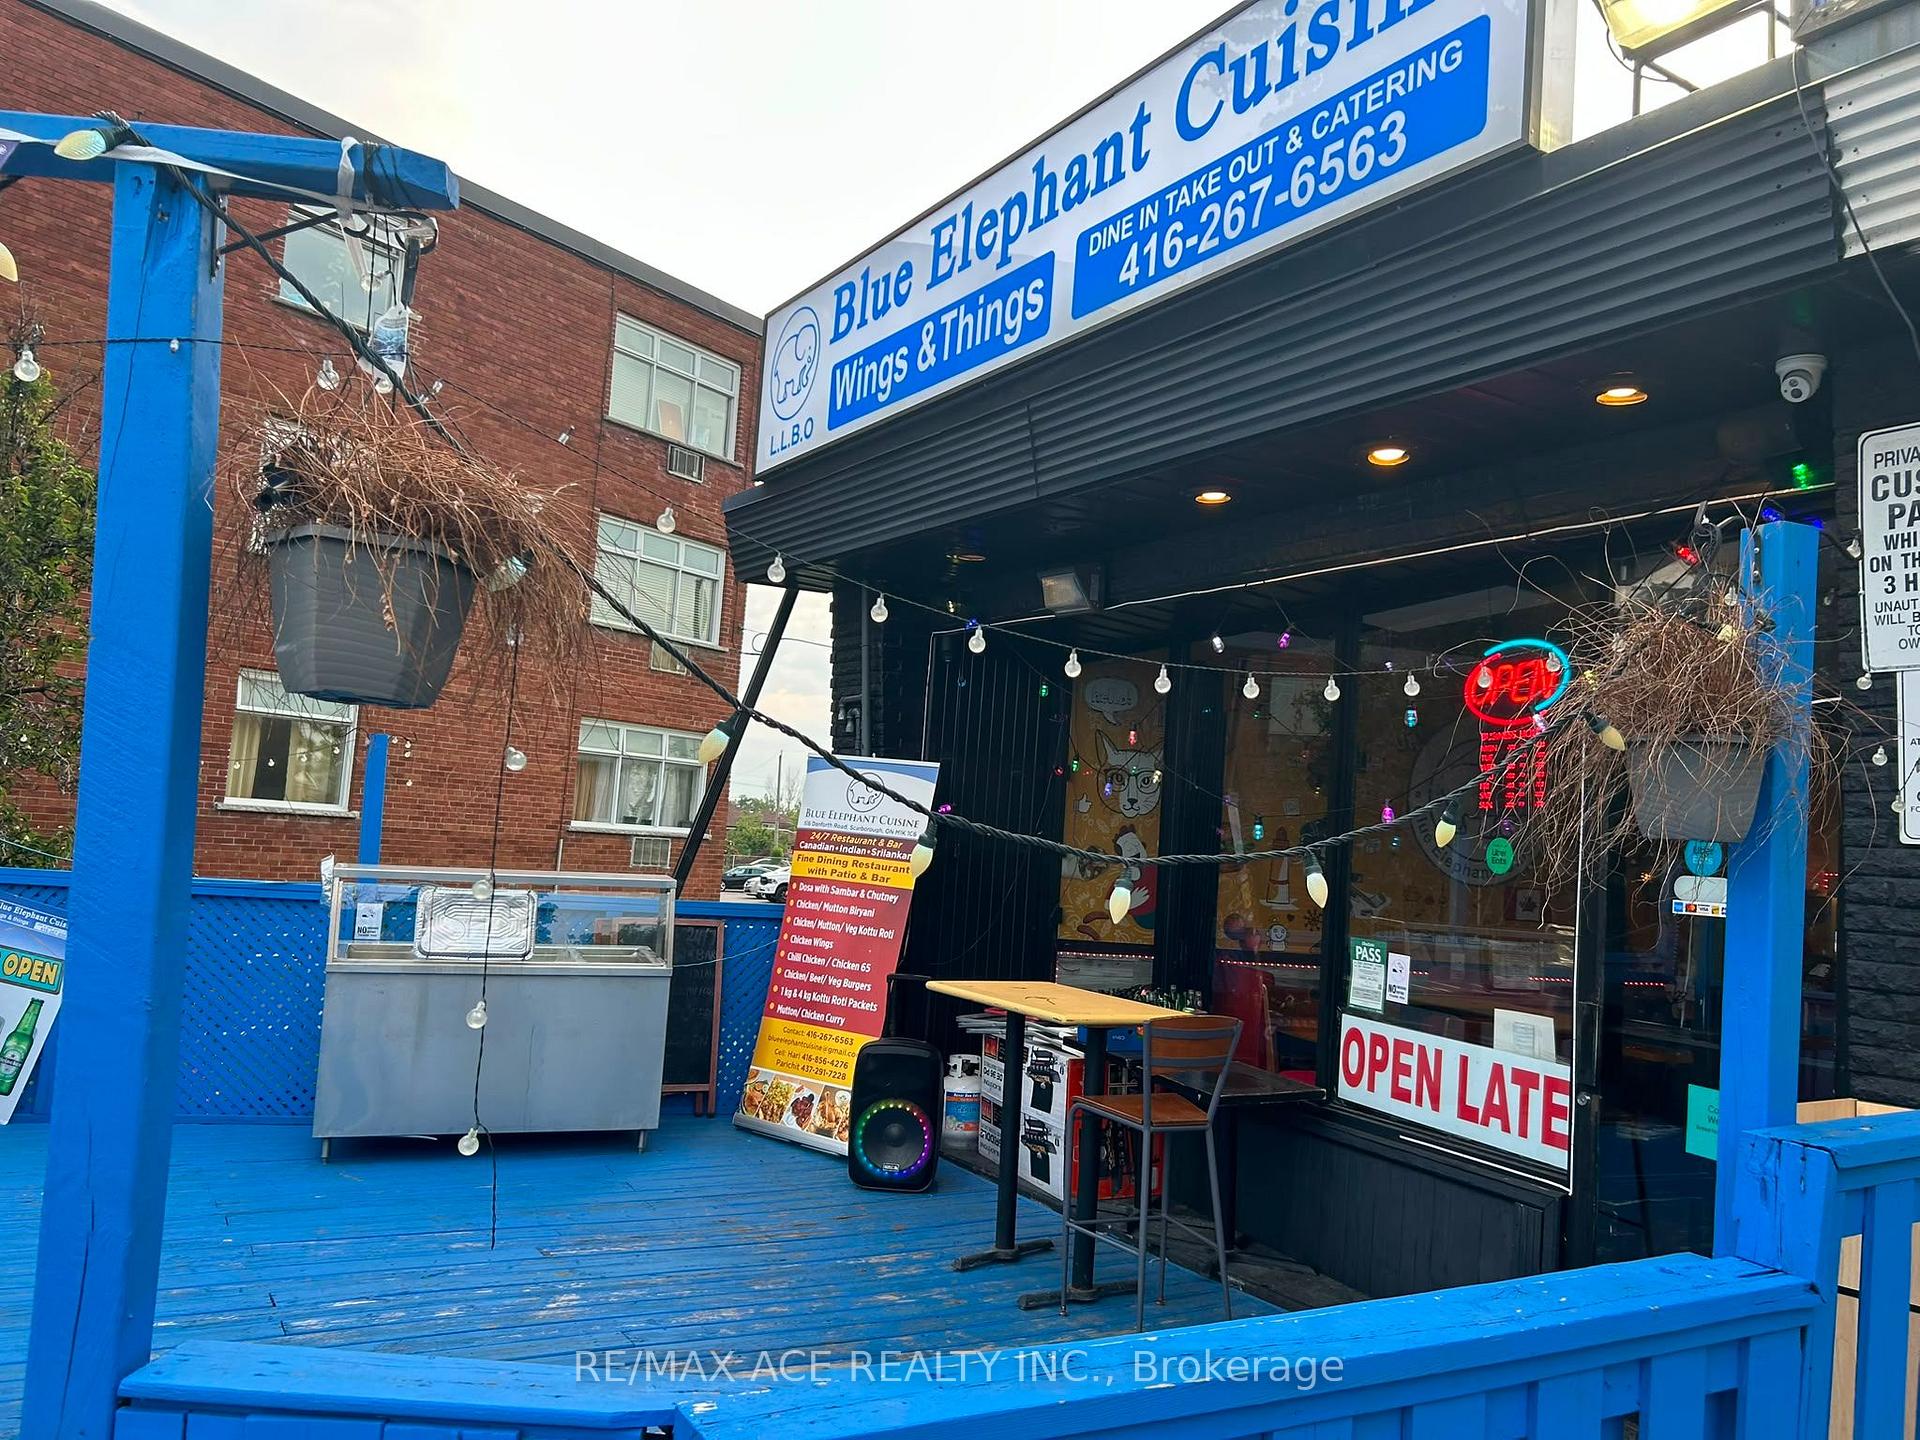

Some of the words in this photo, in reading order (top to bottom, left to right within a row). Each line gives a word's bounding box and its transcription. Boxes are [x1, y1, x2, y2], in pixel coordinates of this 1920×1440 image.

[1089, 221, 1134, 256] DINE
[1140, 201, 1159, 230] IN
[1165, 167, 1221, 216] TAKE
[1228, 136, 1279, 184] OUT
[1285, 125, 1304, 155] &
[1311, 38, 1464, 140] CATERING
[829, 260, 913, 345] Blue
[926, 101, 1151, 290] Elephant
[1175, 0, 1438, 141] Cuis
[1118, 110, 1407, 287] 416-267-6563
[834, 345, 909, 412] Wings
[769, 417, 814, 456] L.L.B.O
[1884, 531, 1918, 551] WHI
[1870, 555, 1892, 573] ON
[1883, 575, 1897, 594] 3
[1875, 598, 1919, 613] UNAUT
[1874, 613, 1906, 626] WILL
[1470, 659, 1561, 707] OPEN
[805, 808, 826, 819] BLUE
[828, 810, 878, 824] ELEPHANT
[880, 815, 920, 829] CUISINE
[799, 841, 834, 851] Canadian
[839, 845, 866, 855] Indian
[810, 831, 830, 841] 24/7
[830, 833, 878, 846] Restaurant
[878, 838, 886, 846] &
[887, 839, 903, 849] Bar
[796, 854, 814, 863] Fine
[817, 856, 849, 868] Dining
[851, 859, 911, 874] Restaurant
[807, 867, 828, 876] with
[830, 869, 857, 879] Patio
[860, 872, 868, 881] &
[871, 874, 891, 883] Bar
[799, 882, 814, 892] Dosa
[814, 883, 830, 894] with
[830, 885, 859, 898] Sambar
[859, 889, 866, 898] &
[866, 889, 899, 904] Chutney
[823, 902, 849, 914] Mutton
[849, 905, 875, 917] Biryani
[358, 926, 368, 934] NO
[845, 923, 858, 935] Veg
[858, 925, 878, 937] Kottu
[879, 927, 895, 939] Roti
[790, 934, 813, 945] Chicken
[813, 937, 834, 949] Wings
[802, 953, 825, 966] Chicken
[831, 958, 860, 971] Chicken
[860, 962, 872, 973] 65
[1355, 945, 1382, 963] PASS
[3, 953, 59, 985] OPEN
[828, 975, 843, 988] Veg
[843, 978, 872, 991] Burgers
[1388, 984, 1397, 994] NO
[803, 990, 812, 1001] kg
[812, 992, 831, 1004] Kottu
[831, 995, 848, 1007] Roti
[848, 998, 878, 1012] Packets
[801, 1008, 825, 1021] Chicken
[825, 1013, 846, 1026] Curry
[806, 1030, 854, 1046] 416-267-6563
[1341, 1027, 1444, 1113] OPEN
[1456, 1054, 1571, 1150] LATE
